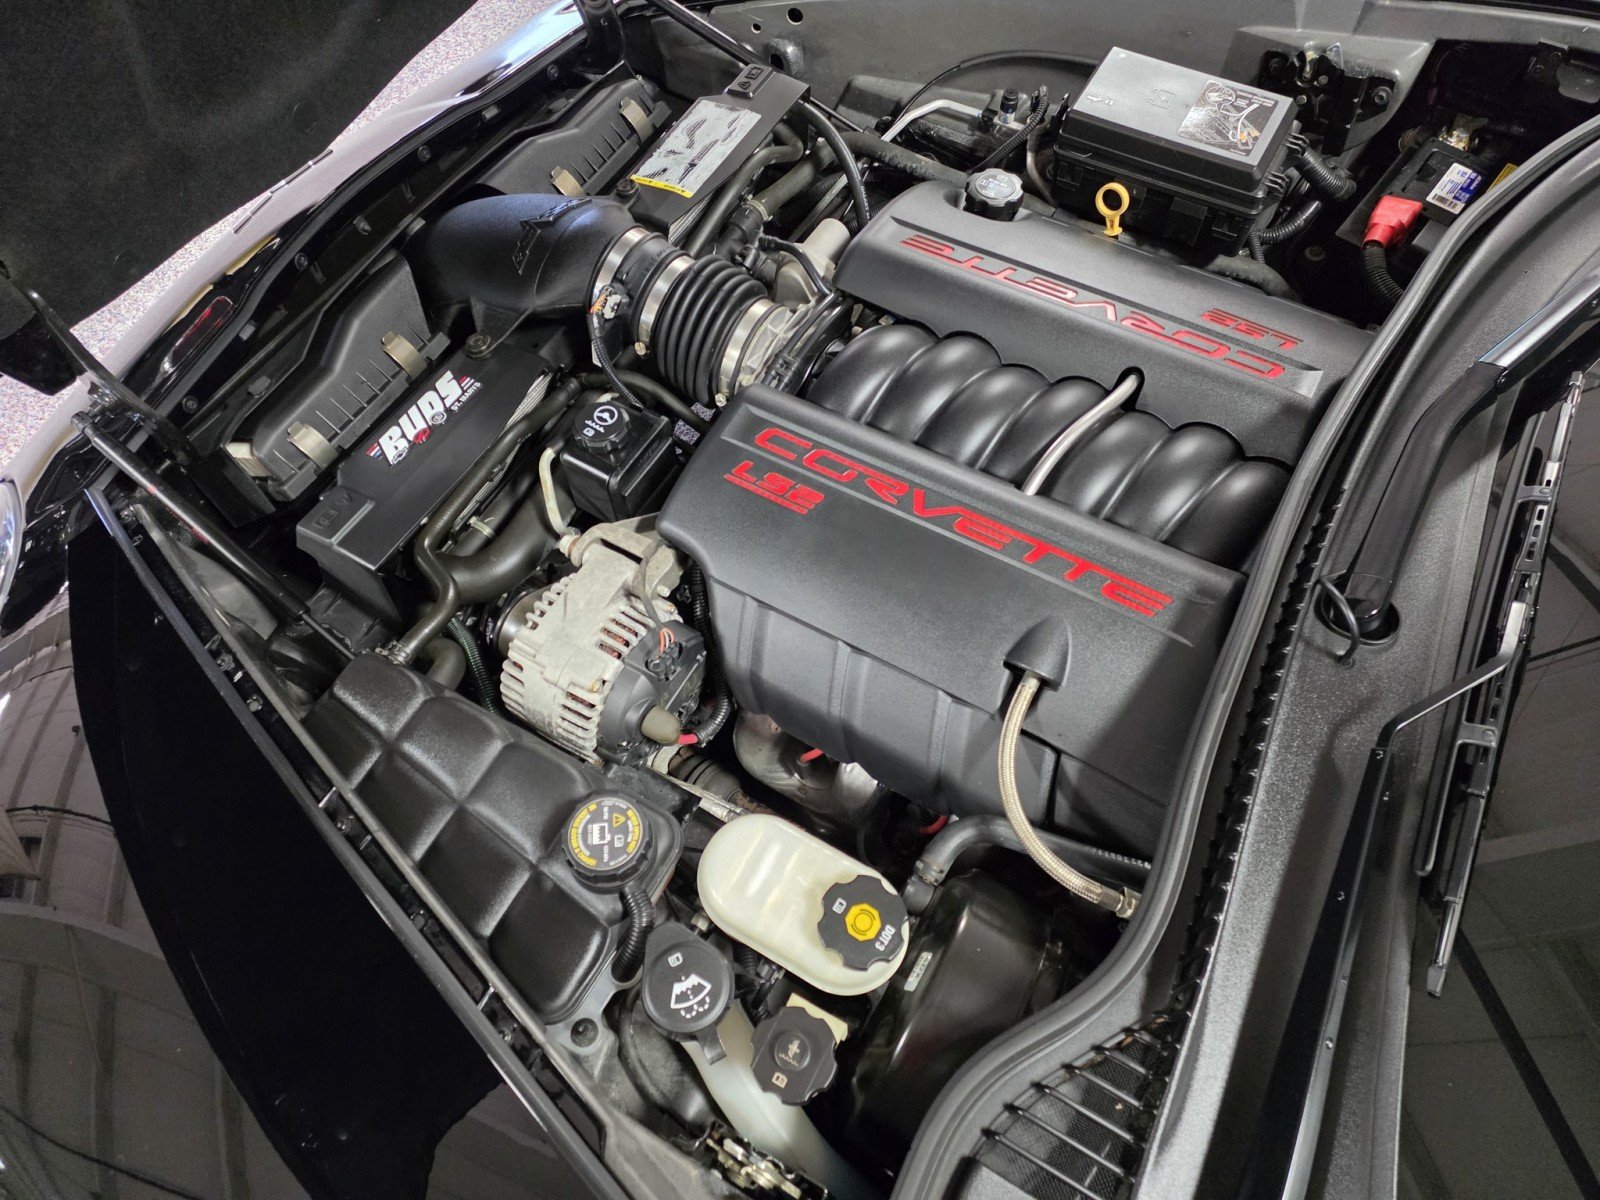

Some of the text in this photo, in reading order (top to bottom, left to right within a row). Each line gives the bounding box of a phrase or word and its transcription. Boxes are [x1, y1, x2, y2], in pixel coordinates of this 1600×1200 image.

[900, 234, 1287, 380] CORVETTE
[378, 370, 463, 466] BUDS
[754, 427, 1173, 618] CORVETTE
